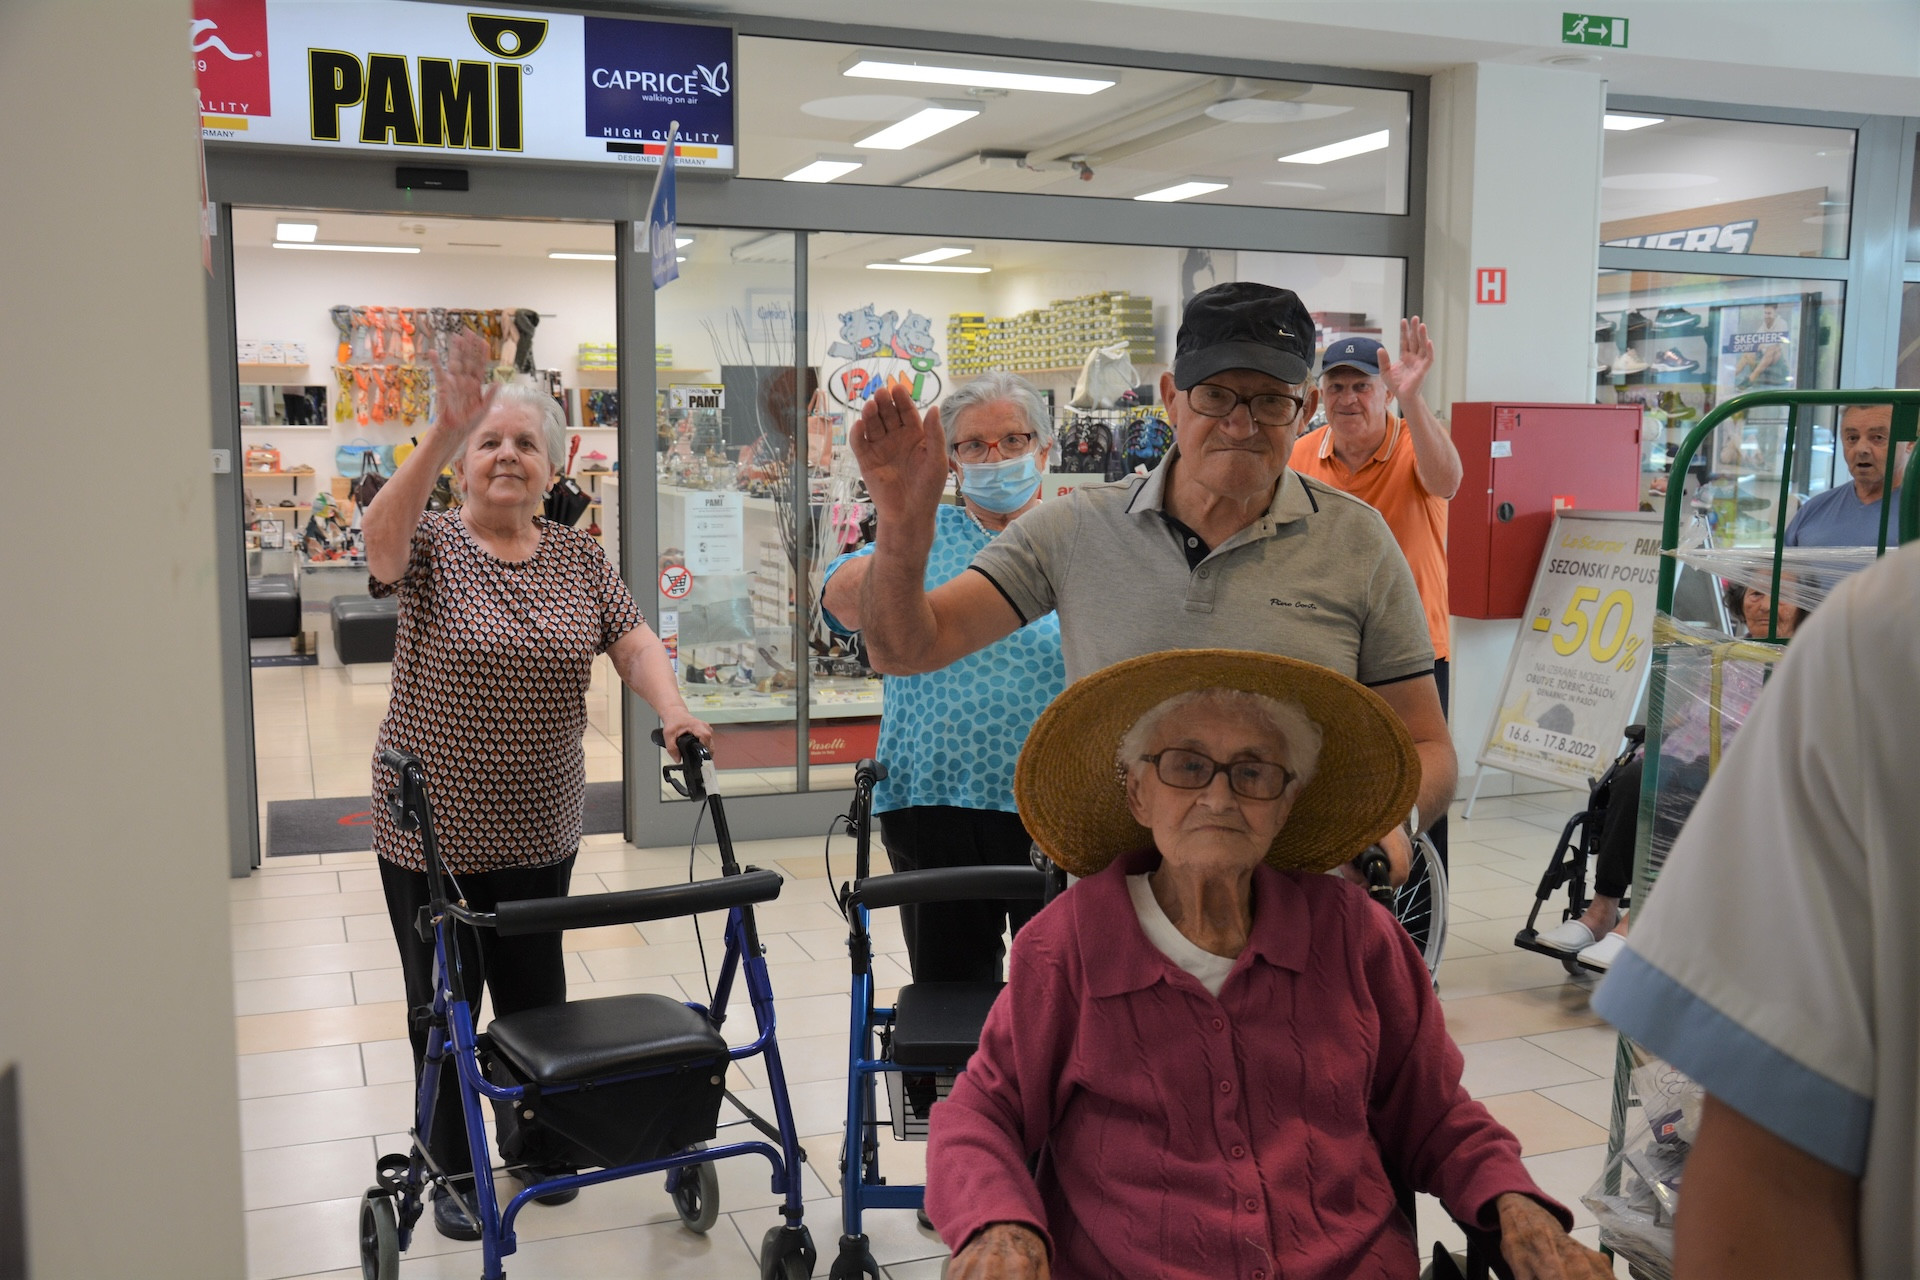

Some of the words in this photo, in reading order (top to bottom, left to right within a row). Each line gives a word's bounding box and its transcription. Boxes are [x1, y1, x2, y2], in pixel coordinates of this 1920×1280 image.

[592, 68, 698, 95] CAPRICE
[642, 94, 673, 104] walking
[687, 97, 699, 105] air
[603, 127, 642, 138] HIGH
[617, 154, 657, 163] DESIGNED
[1734, 332, 1785, 345] SKECHERS
[1732, 344, 1754, 353] SPORT
[689, 395, 719, 408] PAMI
[1514, 413, 1521, 427] 1
[1549, 559, 1609, 579] SEZONSKI
[1269, 598, 1293, 607] Piero
[1539, 607, 1551, 617] DO
[1534, 662, 1546, 673] NA
[1508, 725, 1532, 744] 16.6.
[1543, 733, 1597, 760] 17.8.2022
